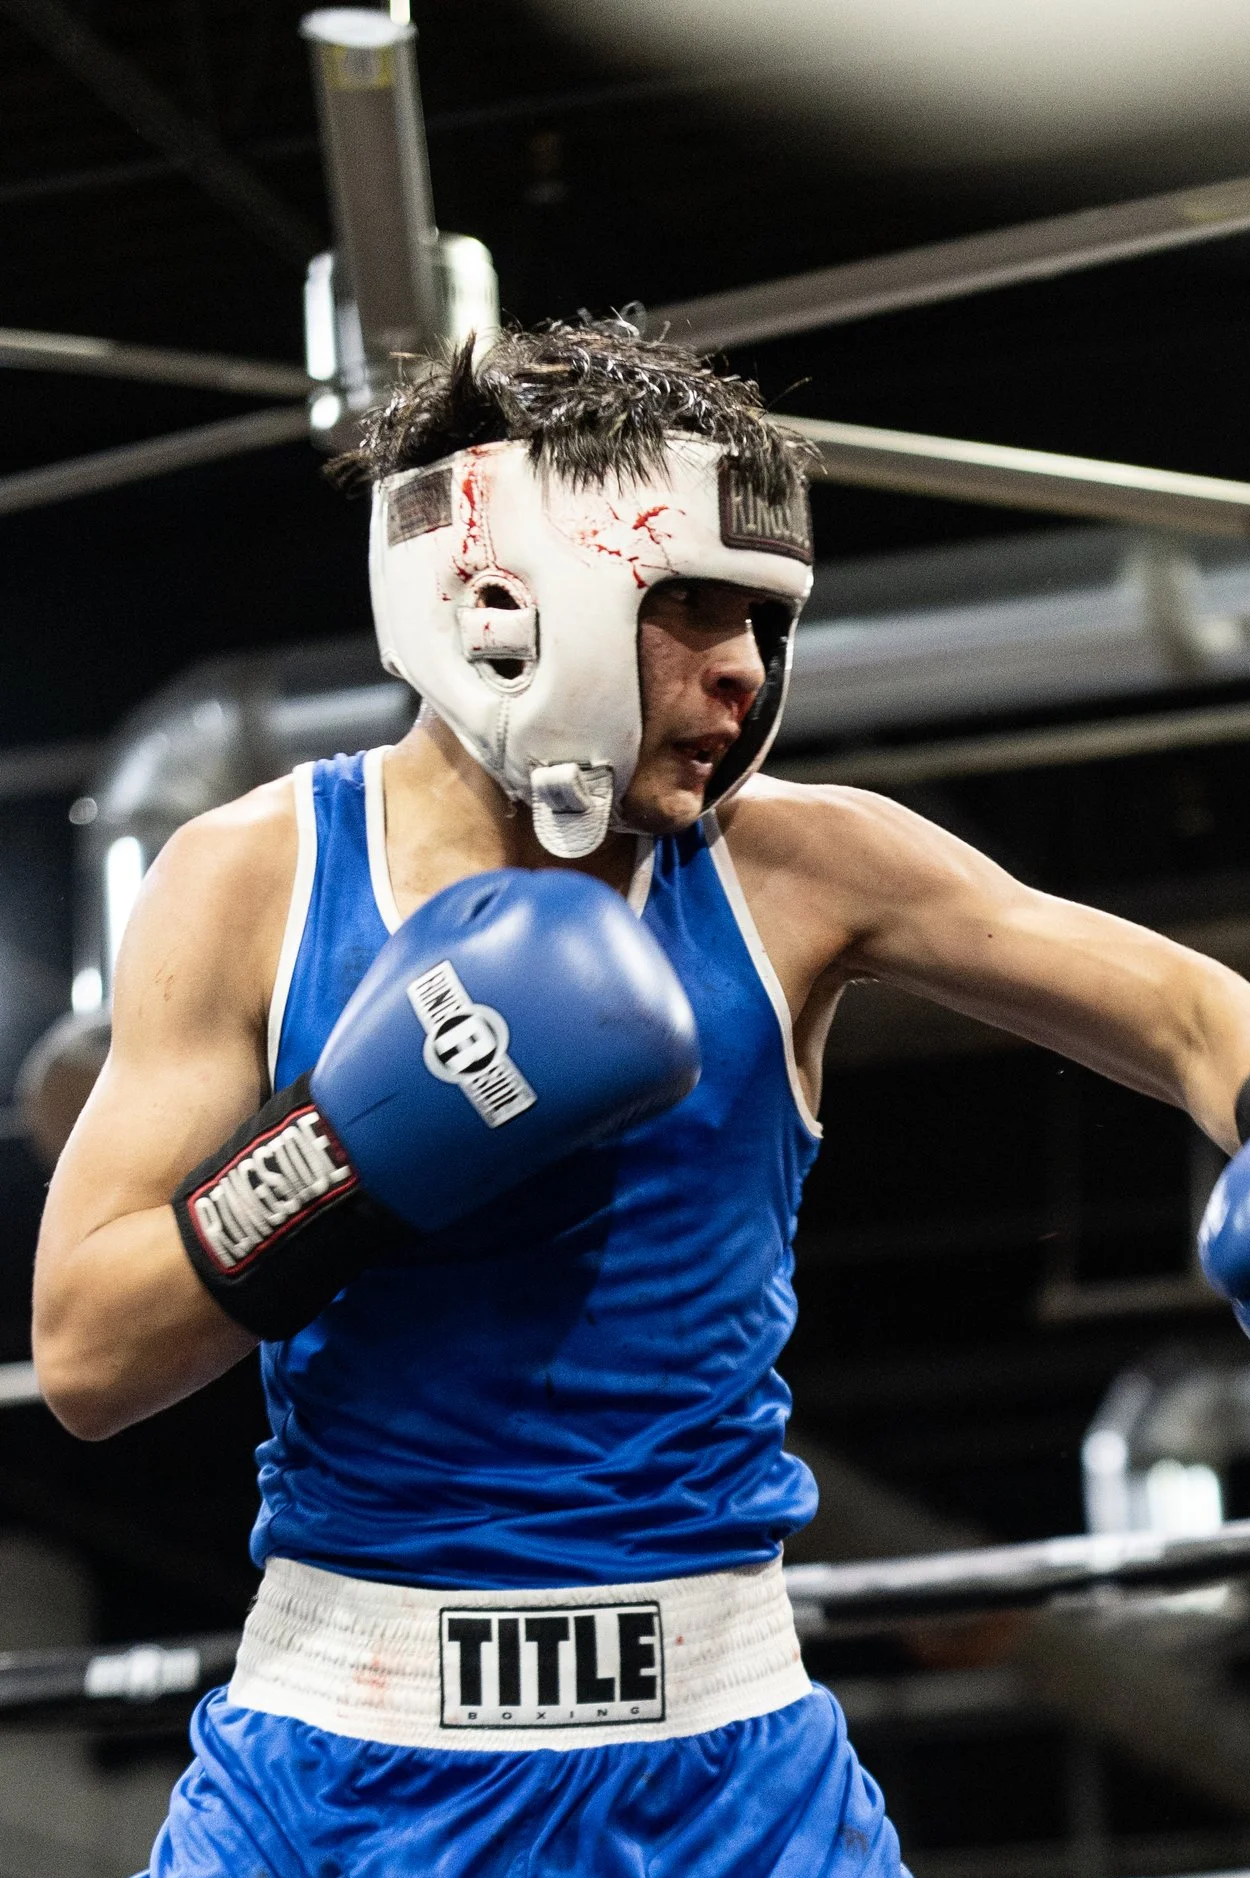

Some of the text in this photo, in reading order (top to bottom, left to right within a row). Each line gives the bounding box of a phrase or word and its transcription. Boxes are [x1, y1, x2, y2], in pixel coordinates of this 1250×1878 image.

[194, 1111, 352, 1269] RINGSIDE
[447, 1612, 659, 1707] TITLE
[468, 1707, 640, 1720] BOXING
